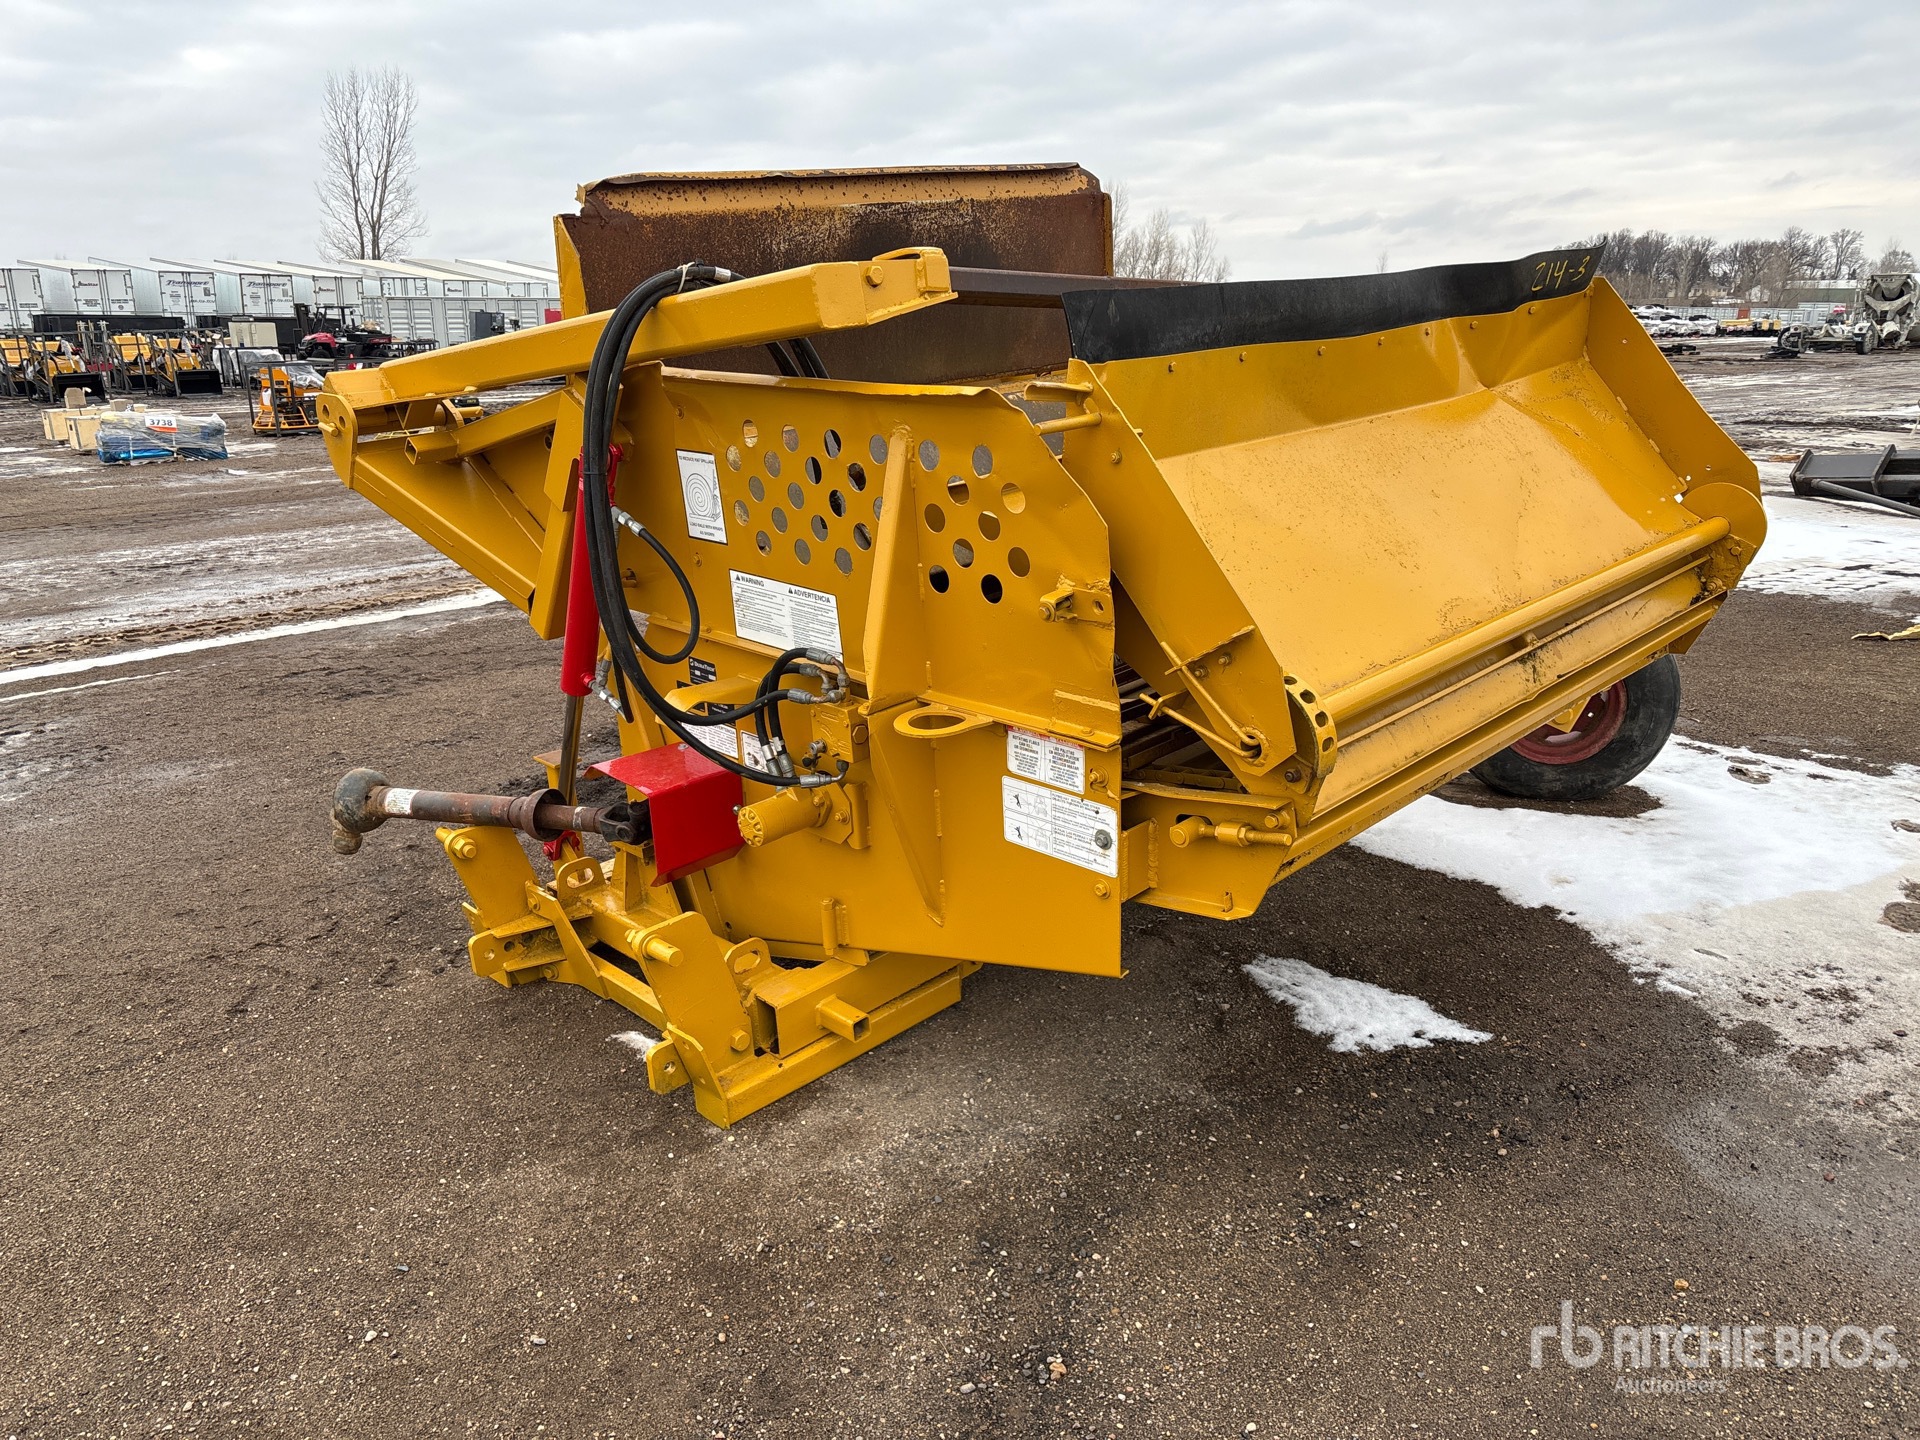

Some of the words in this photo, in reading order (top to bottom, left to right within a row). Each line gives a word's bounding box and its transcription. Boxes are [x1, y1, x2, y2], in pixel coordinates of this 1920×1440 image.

[1531, 255, 1591, 291] 214-3
[149, 418, 173, 426] 3738
[741, 575, 765, 587] WARNING
[794, 589, 831, 603] ADVERTENCIA
